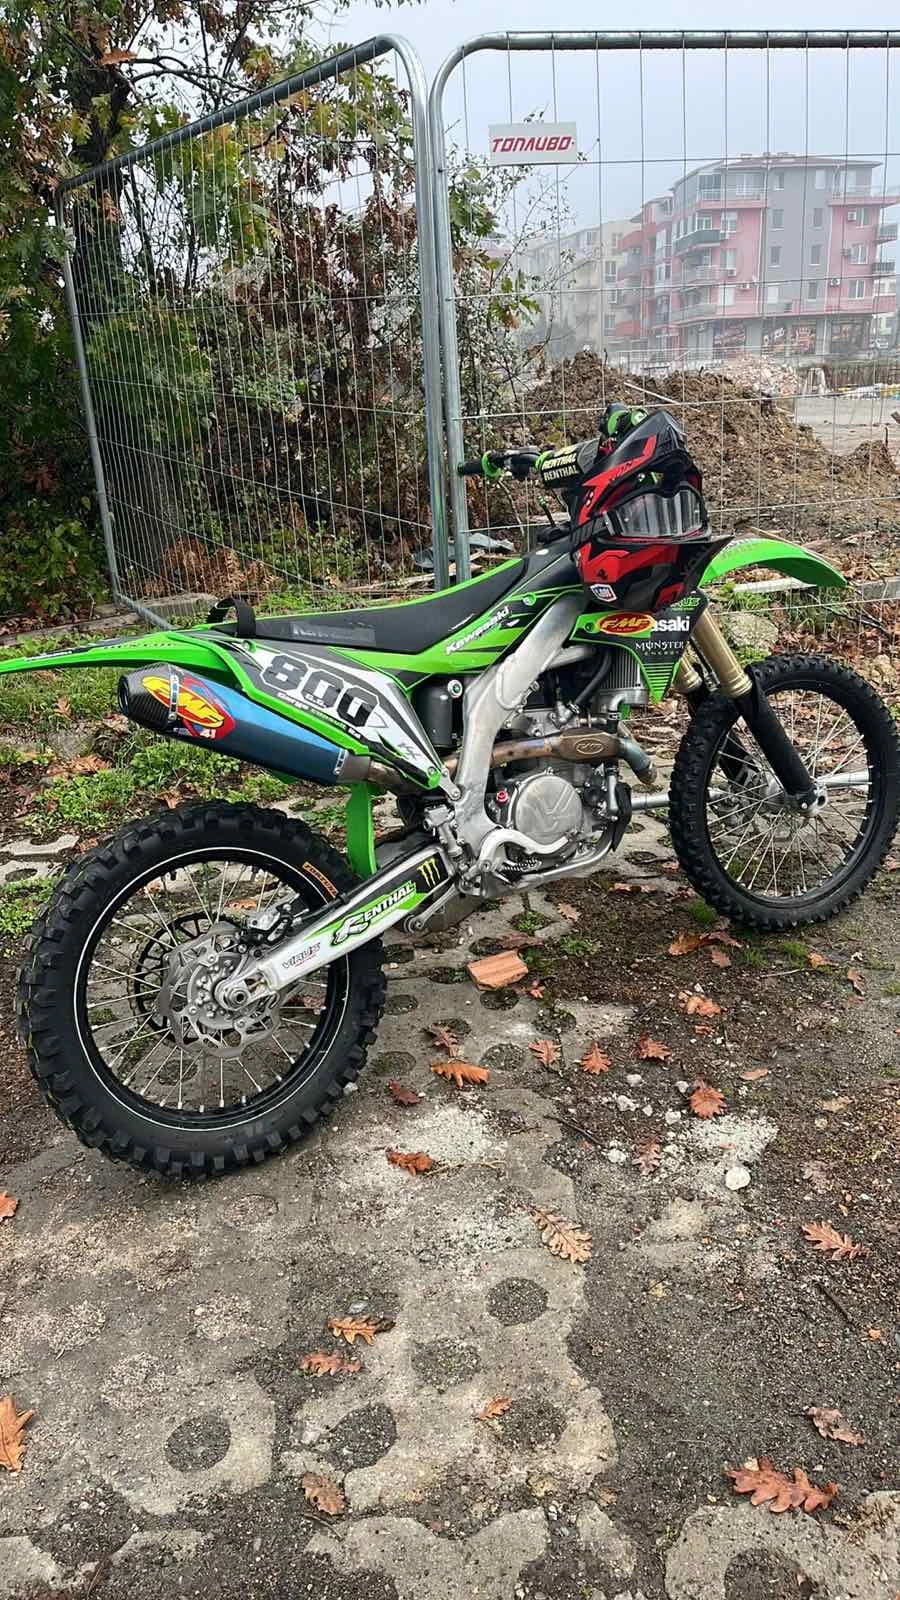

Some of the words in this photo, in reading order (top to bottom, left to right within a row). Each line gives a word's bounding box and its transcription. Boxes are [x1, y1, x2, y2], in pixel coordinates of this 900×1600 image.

[543, 465, 579, 481] RENTHAL
[651, 616, 690, 632] asaki
[261, 654, 379, 727] 800
[331, 882, 416, 945] RENTHAL
